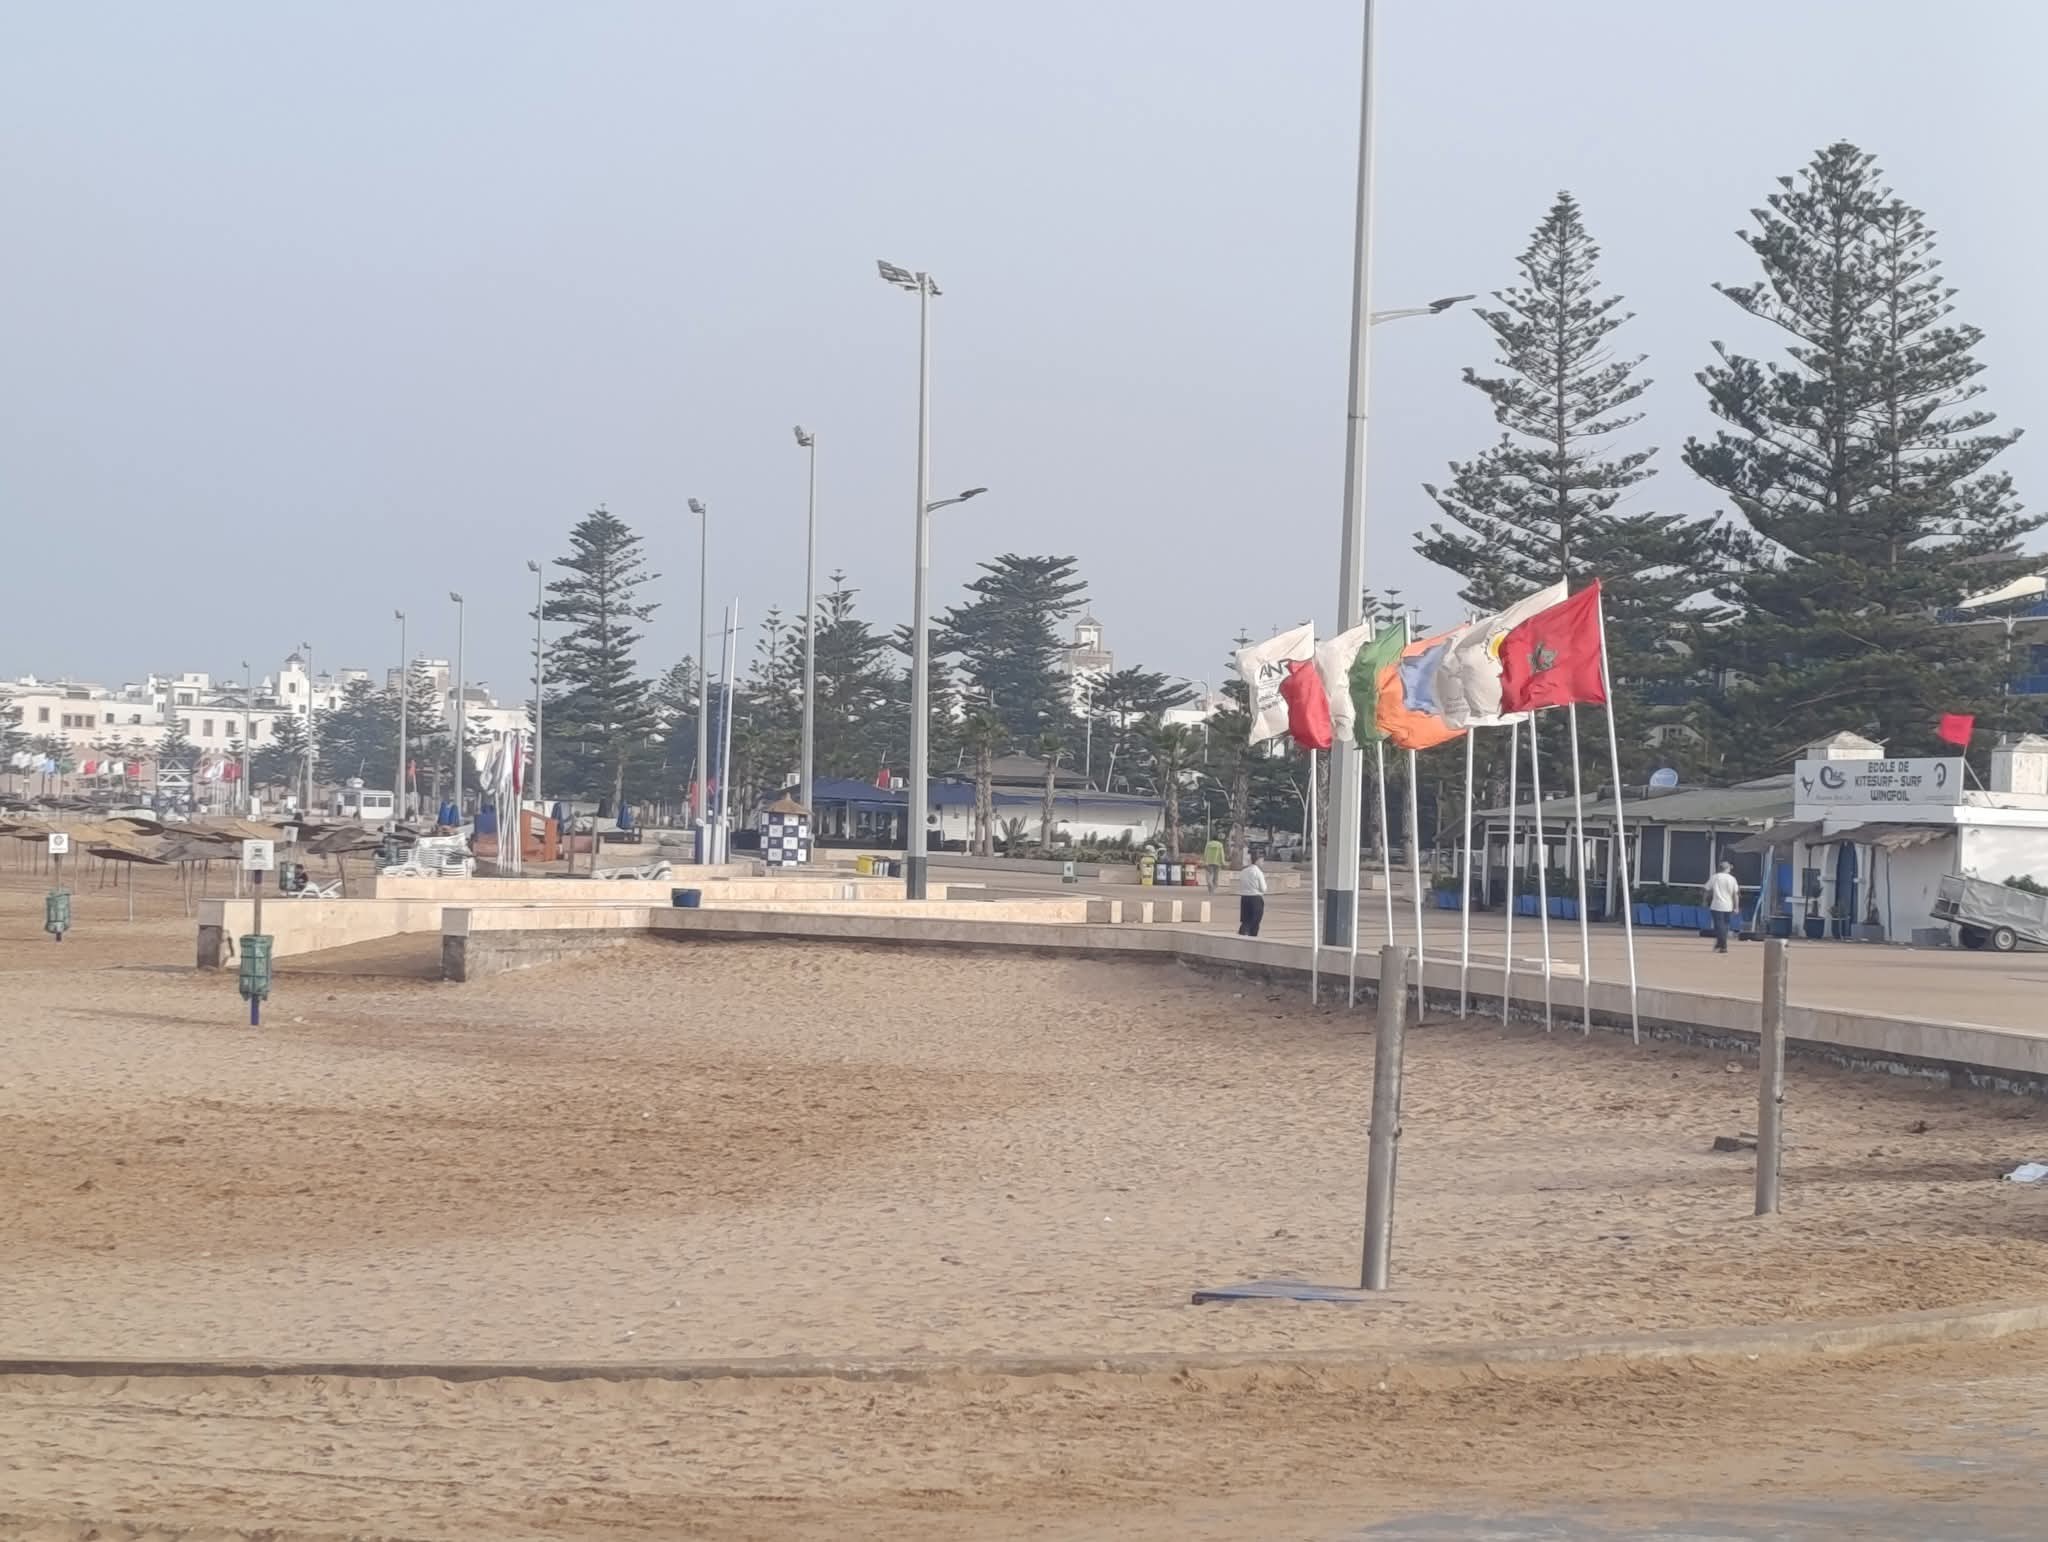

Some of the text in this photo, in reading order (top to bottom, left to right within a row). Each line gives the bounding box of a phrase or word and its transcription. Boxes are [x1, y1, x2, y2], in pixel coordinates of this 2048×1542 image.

[1868, 761, 1909, 773] ECOLE DE
[1870, 790, 1910, 801] WINGFOIL
